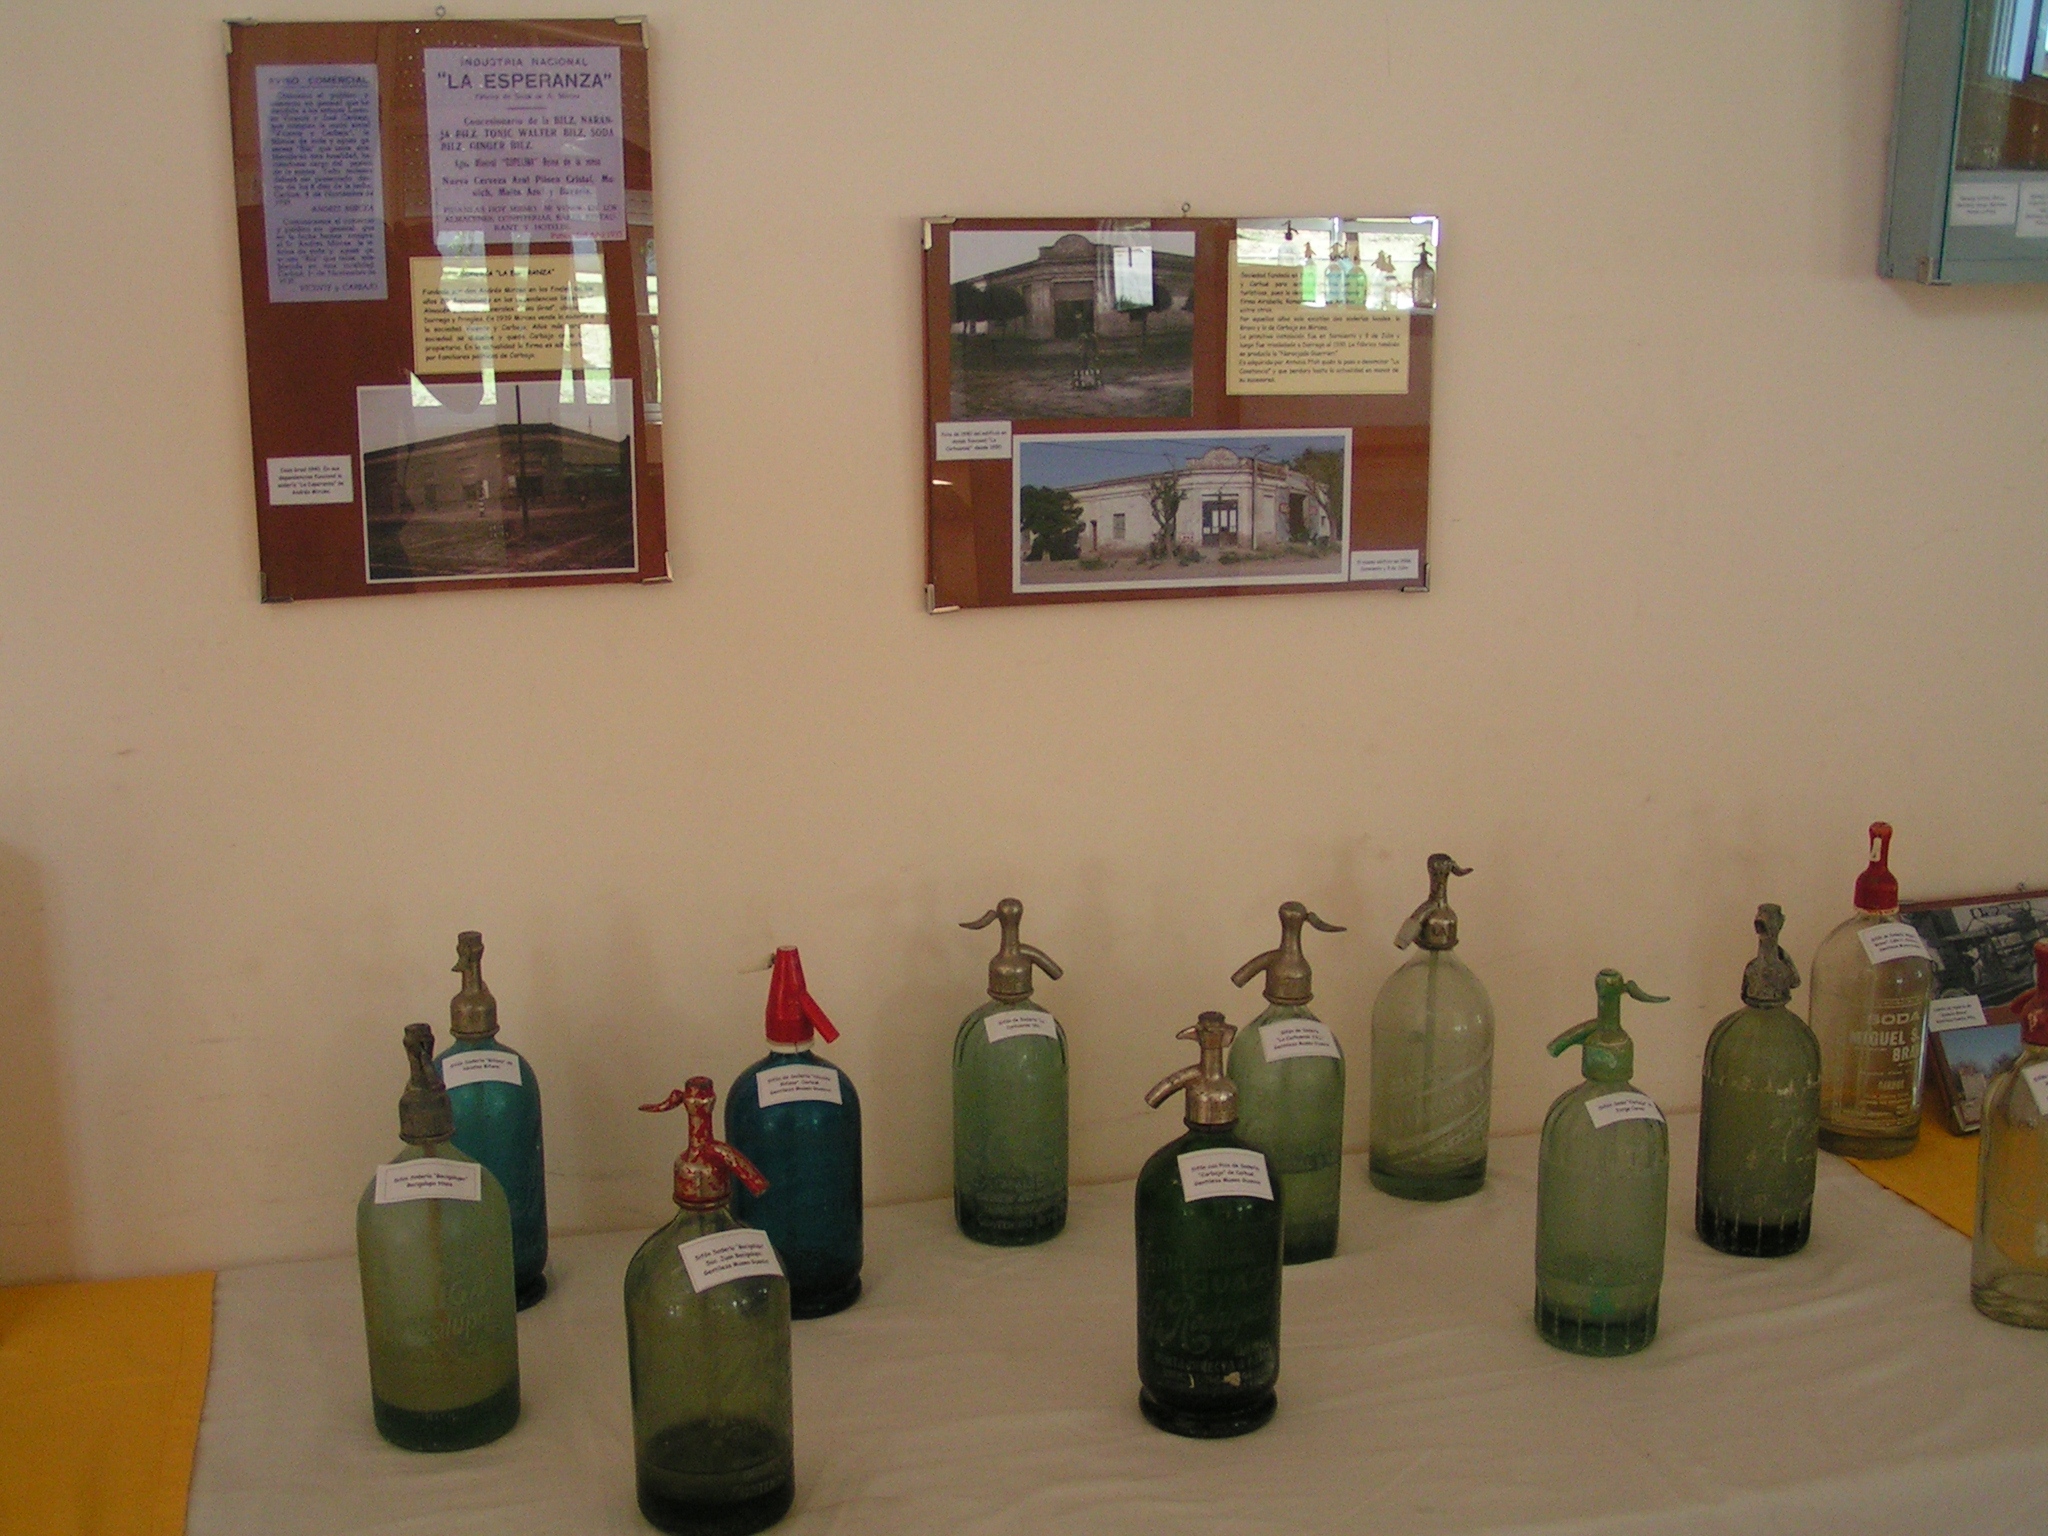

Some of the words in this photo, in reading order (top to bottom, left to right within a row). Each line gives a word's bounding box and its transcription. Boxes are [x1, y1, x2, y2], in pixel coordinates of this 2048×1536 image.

[461, 57, 523, 67] INDUSTRIA
[532, 57, 588, 66] NACIONAL
[438, 72, 473, 90] "LA
[484, 72, 612, 89] ESPERANZA"
[485, 128, 513, 138] TONIC
[519, 127, 558, 138] WALTER
[510, 269, 555, 278] ERANZA"
